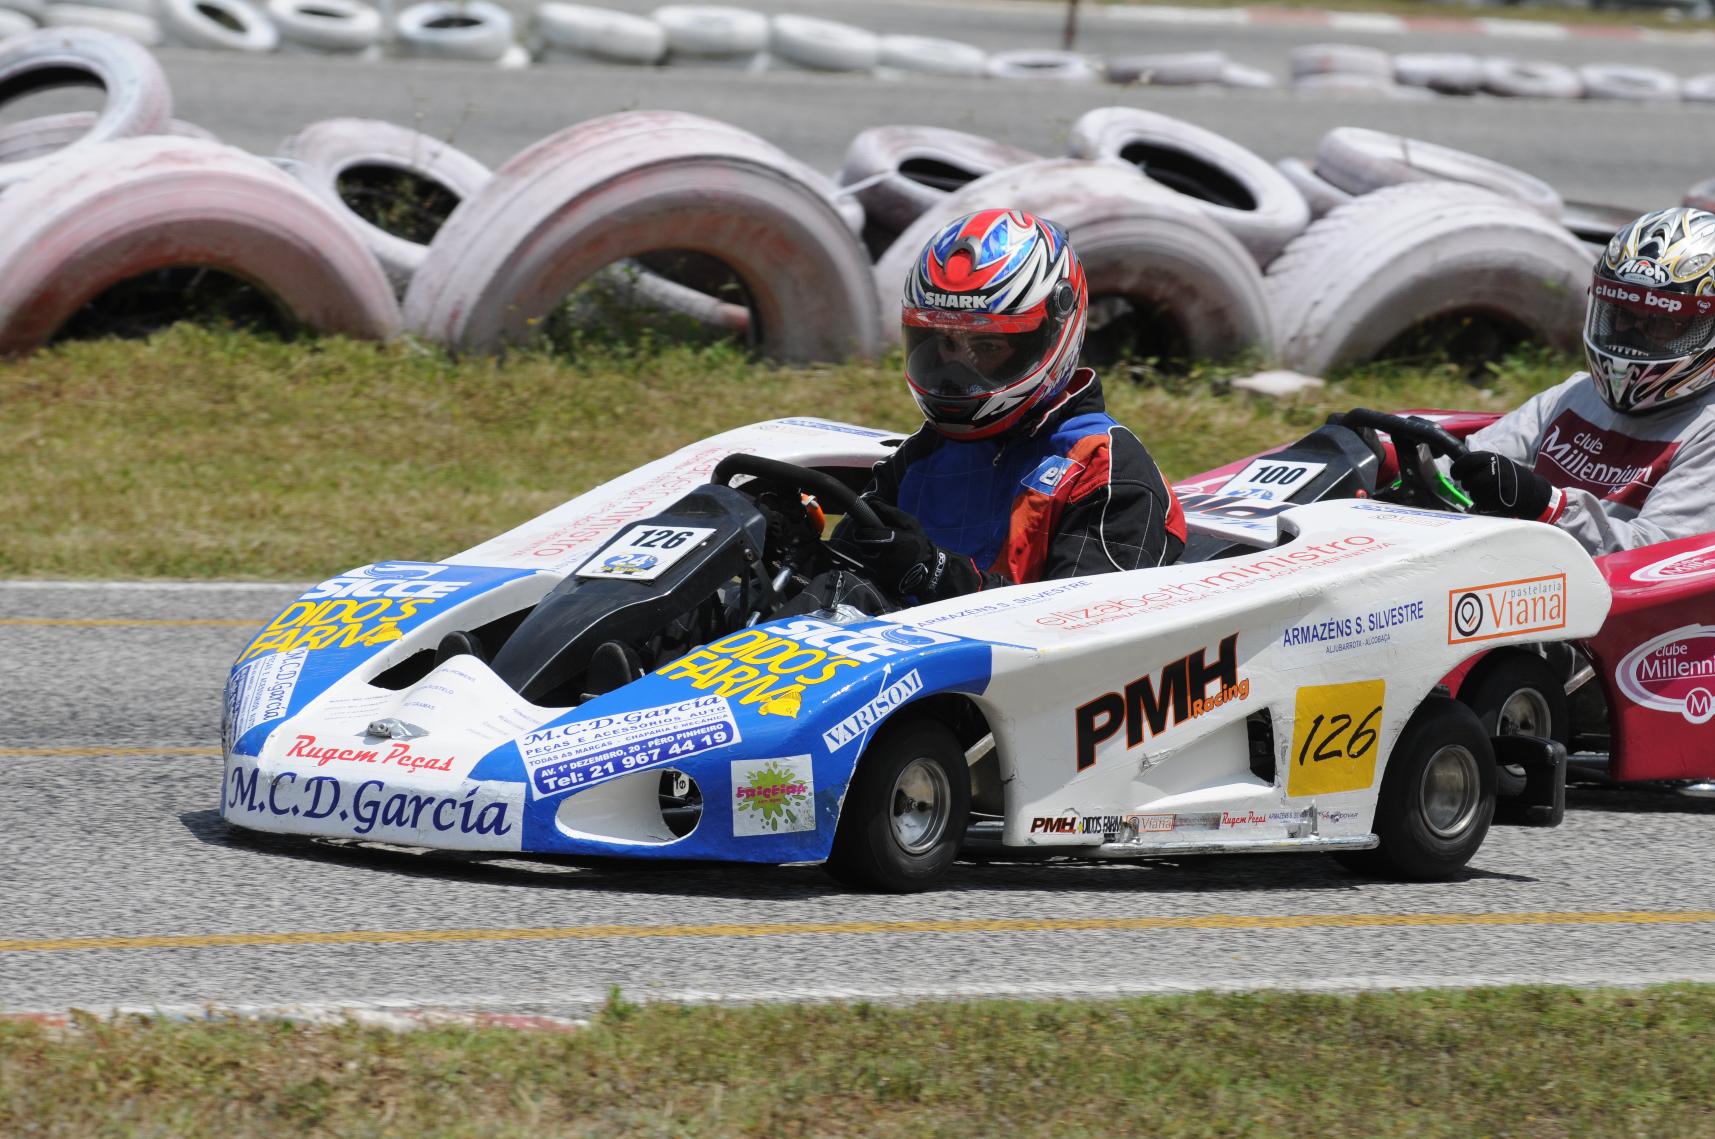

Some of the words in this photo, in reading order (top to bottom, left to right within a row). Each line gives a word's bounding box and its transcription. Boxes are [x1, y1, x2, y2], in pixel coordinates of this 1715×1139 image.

[1617, 259, 1666, 283] Airoh
[925, 291, 988, 309] SHARK
[1595, 284, 1641, 303] clube
[1644, 291, 1682, 313] bcp
[1540, 425, 1653, 484] Millennium
[1248, 465, 1307, 485] 100
[629, 529, 694, 549] 126
[300, 578, 473, 600] SICCE
[1511, 582, 1562, 598] pastelaria
[266, 597, 437, 627] DIDO'S
[1283, 617, 1352, 647] ARMAZÉNS
[1355, 616, 1366, 635] S.
[1368, 601, 1424, 632] SILVESTRE
[1486, 590, 1561, 629] Viana
[235, 622, 398, 664] FARM
[707, 630, 861, 685] DIDO'S
[1656, 643, 1688, 657] clube
[655, 651, 807, 706] FARM
[1190, 676, 1251, 719] Racing
[826, 671, 922, 746] VARISOM
[1075, 631, 1241, 773] PMH
[526, 741, 570, 756] PEÇAS
[690, 706, 726, 718] AUTO
[529, 755, 559, 767] TODAS
[575, 741, 613, 754] MARCAS
[625, 727, 671, 741] CHAPARIA
[541, 767, 557, 778] AV.
[569, 749, 627, 770] DEZEMBRO,
[628, 745, 641, 753] 20
[676, 723, 724, 740] PINHEIRO
[1298, 705, 1383, 766] 126
[286, 735, 379, 767] Rugem
[381, 743, 455, 773] Peças
[543, 772, 585, 790] Tel:
[589, 761, 615, 778] 21
[622, 748, 661, 769] 967
[668, 740, 695, 755] 44
[701, 731, 728, 746] 19
[1030, 816, 1077, 833] PMH
[1141, 817, 1171, 830] Viana
[1221, 811, 1247, 827] Rugem
